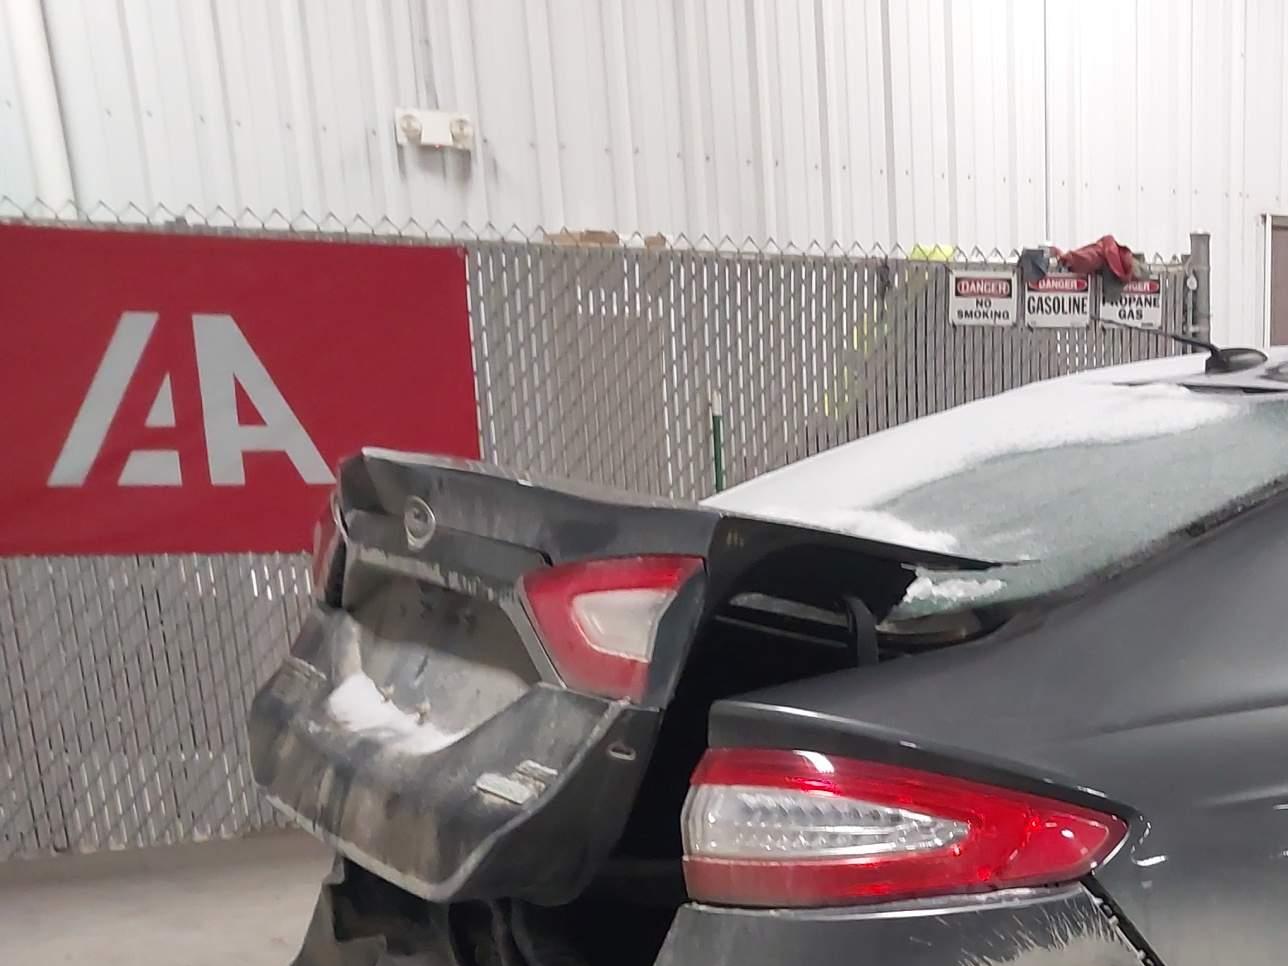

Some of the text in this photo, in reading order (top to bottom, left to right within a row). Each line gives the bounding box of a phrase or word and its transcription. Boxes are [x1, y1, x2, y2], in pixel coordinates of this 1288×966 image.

[961, 279, 1007, 294] DANGER
[1038, 278, 1078, 290] DANGER
[975, 298, 992, 309] NO
[1027, 295, 1088, 315] GASOLINE
[957, 309, 1010, 320] SMOKING
[1118, 309, 1143, 320] GAS
